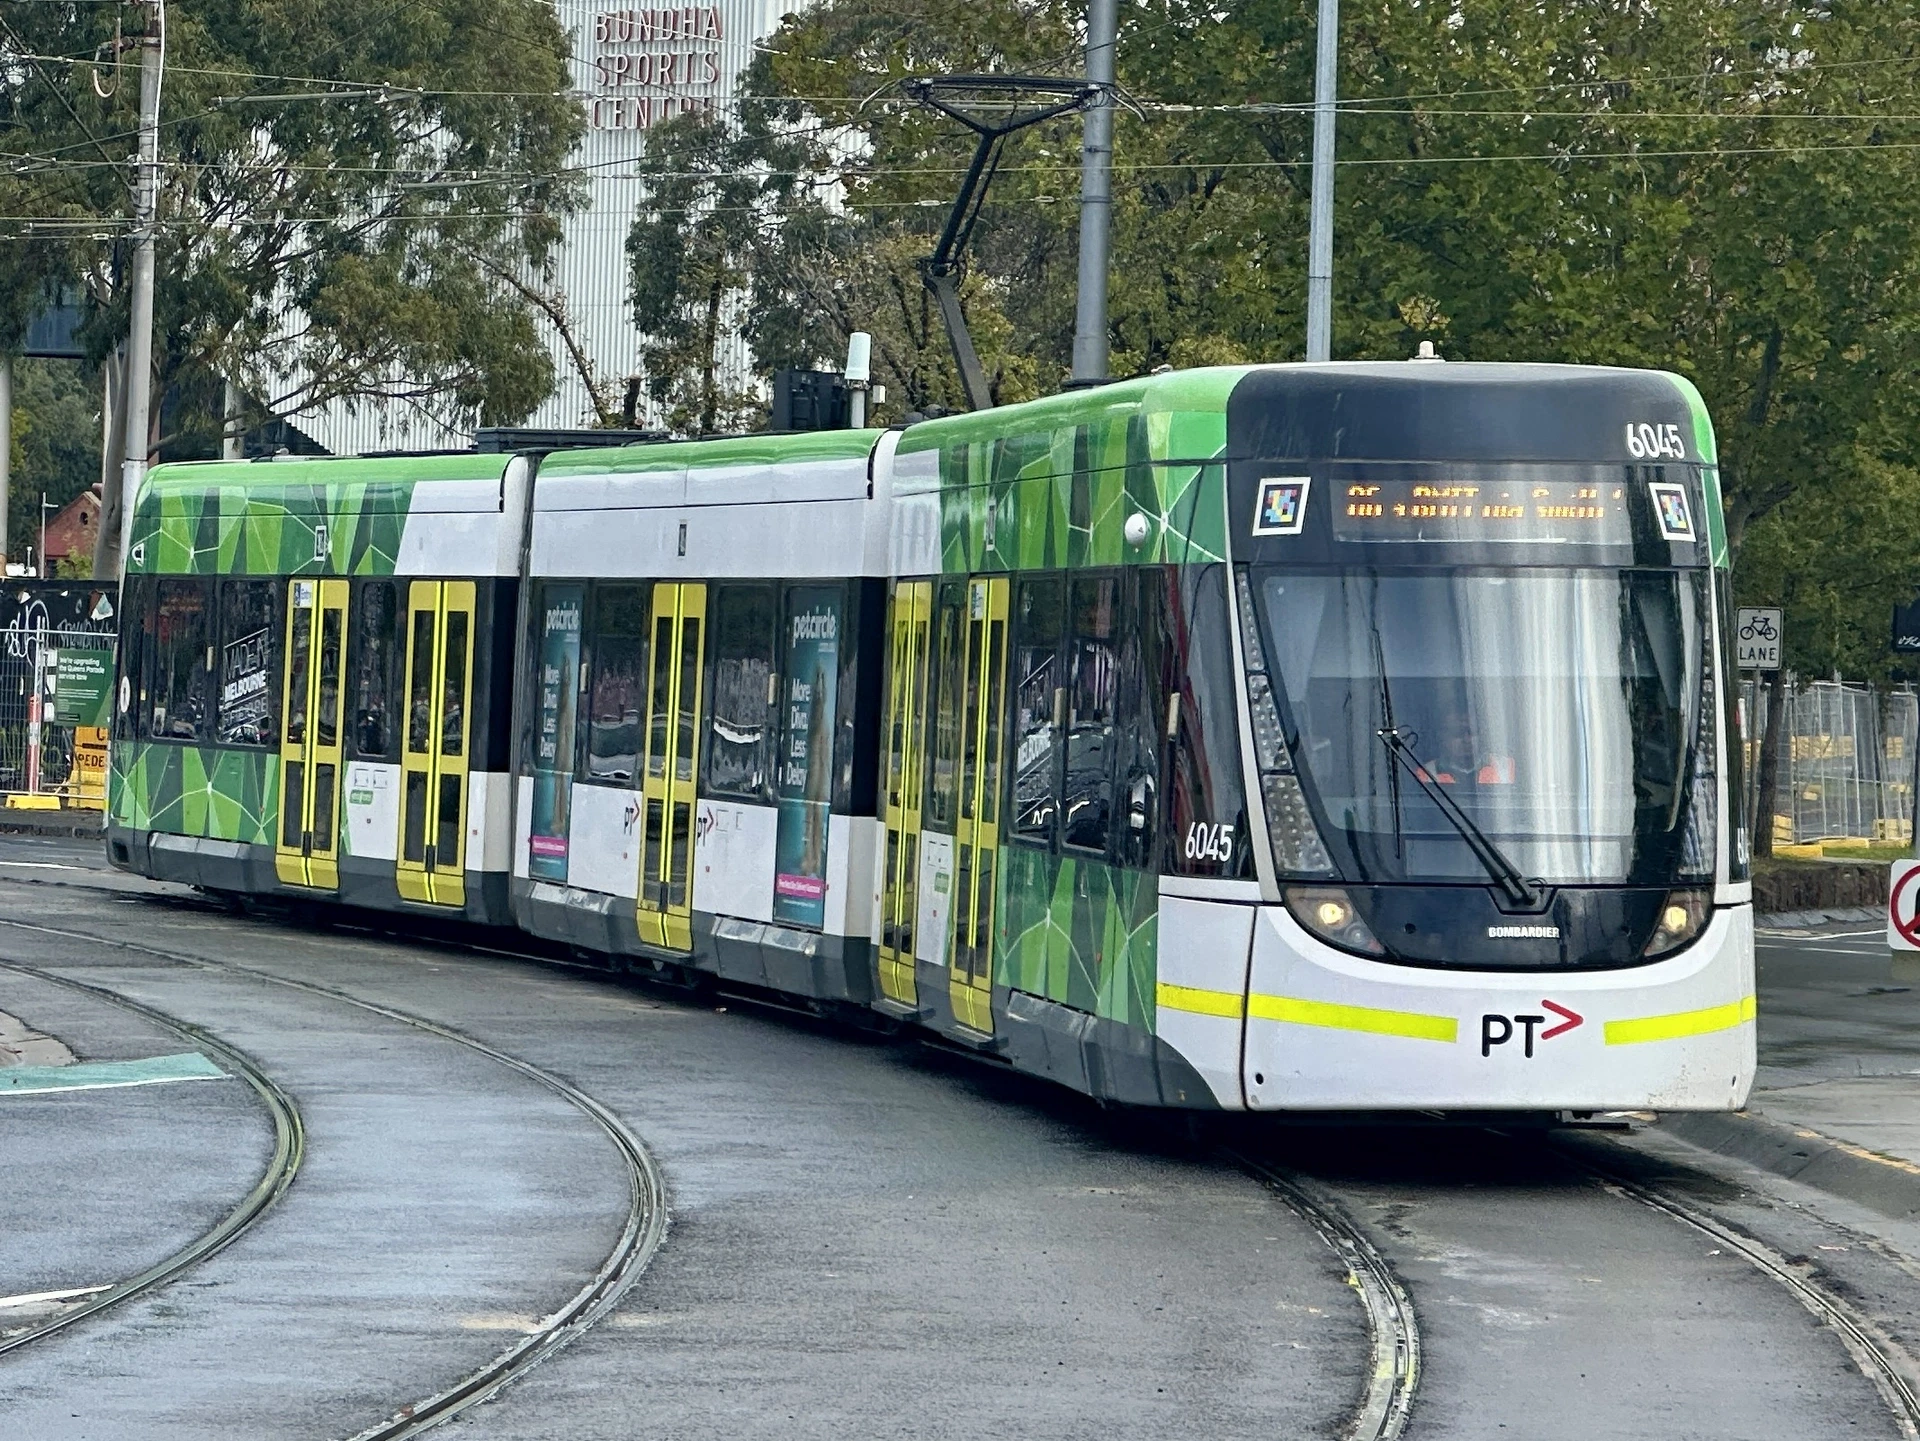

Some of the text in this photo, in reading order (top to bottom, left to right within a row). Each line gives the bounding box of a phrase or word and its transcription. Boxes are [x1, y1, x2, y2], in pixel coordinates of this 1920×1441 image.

[596, 6, 723, 42] BUNDHA
[596, 51, 718, 86] SPORTS
[1626, 422, 1685, 459] 6045
[792, 605, 836, 648] petcircle
[1739, 647, 1777, 662] LANE
[792, 677, 811, 701] More
[790, 733, 806, 758] Less
[786, 761, 808, 793] Delay
[1185, 821, 1234, 862] 6045
[1488, 926, 1560, 938] BOMBARDIER
